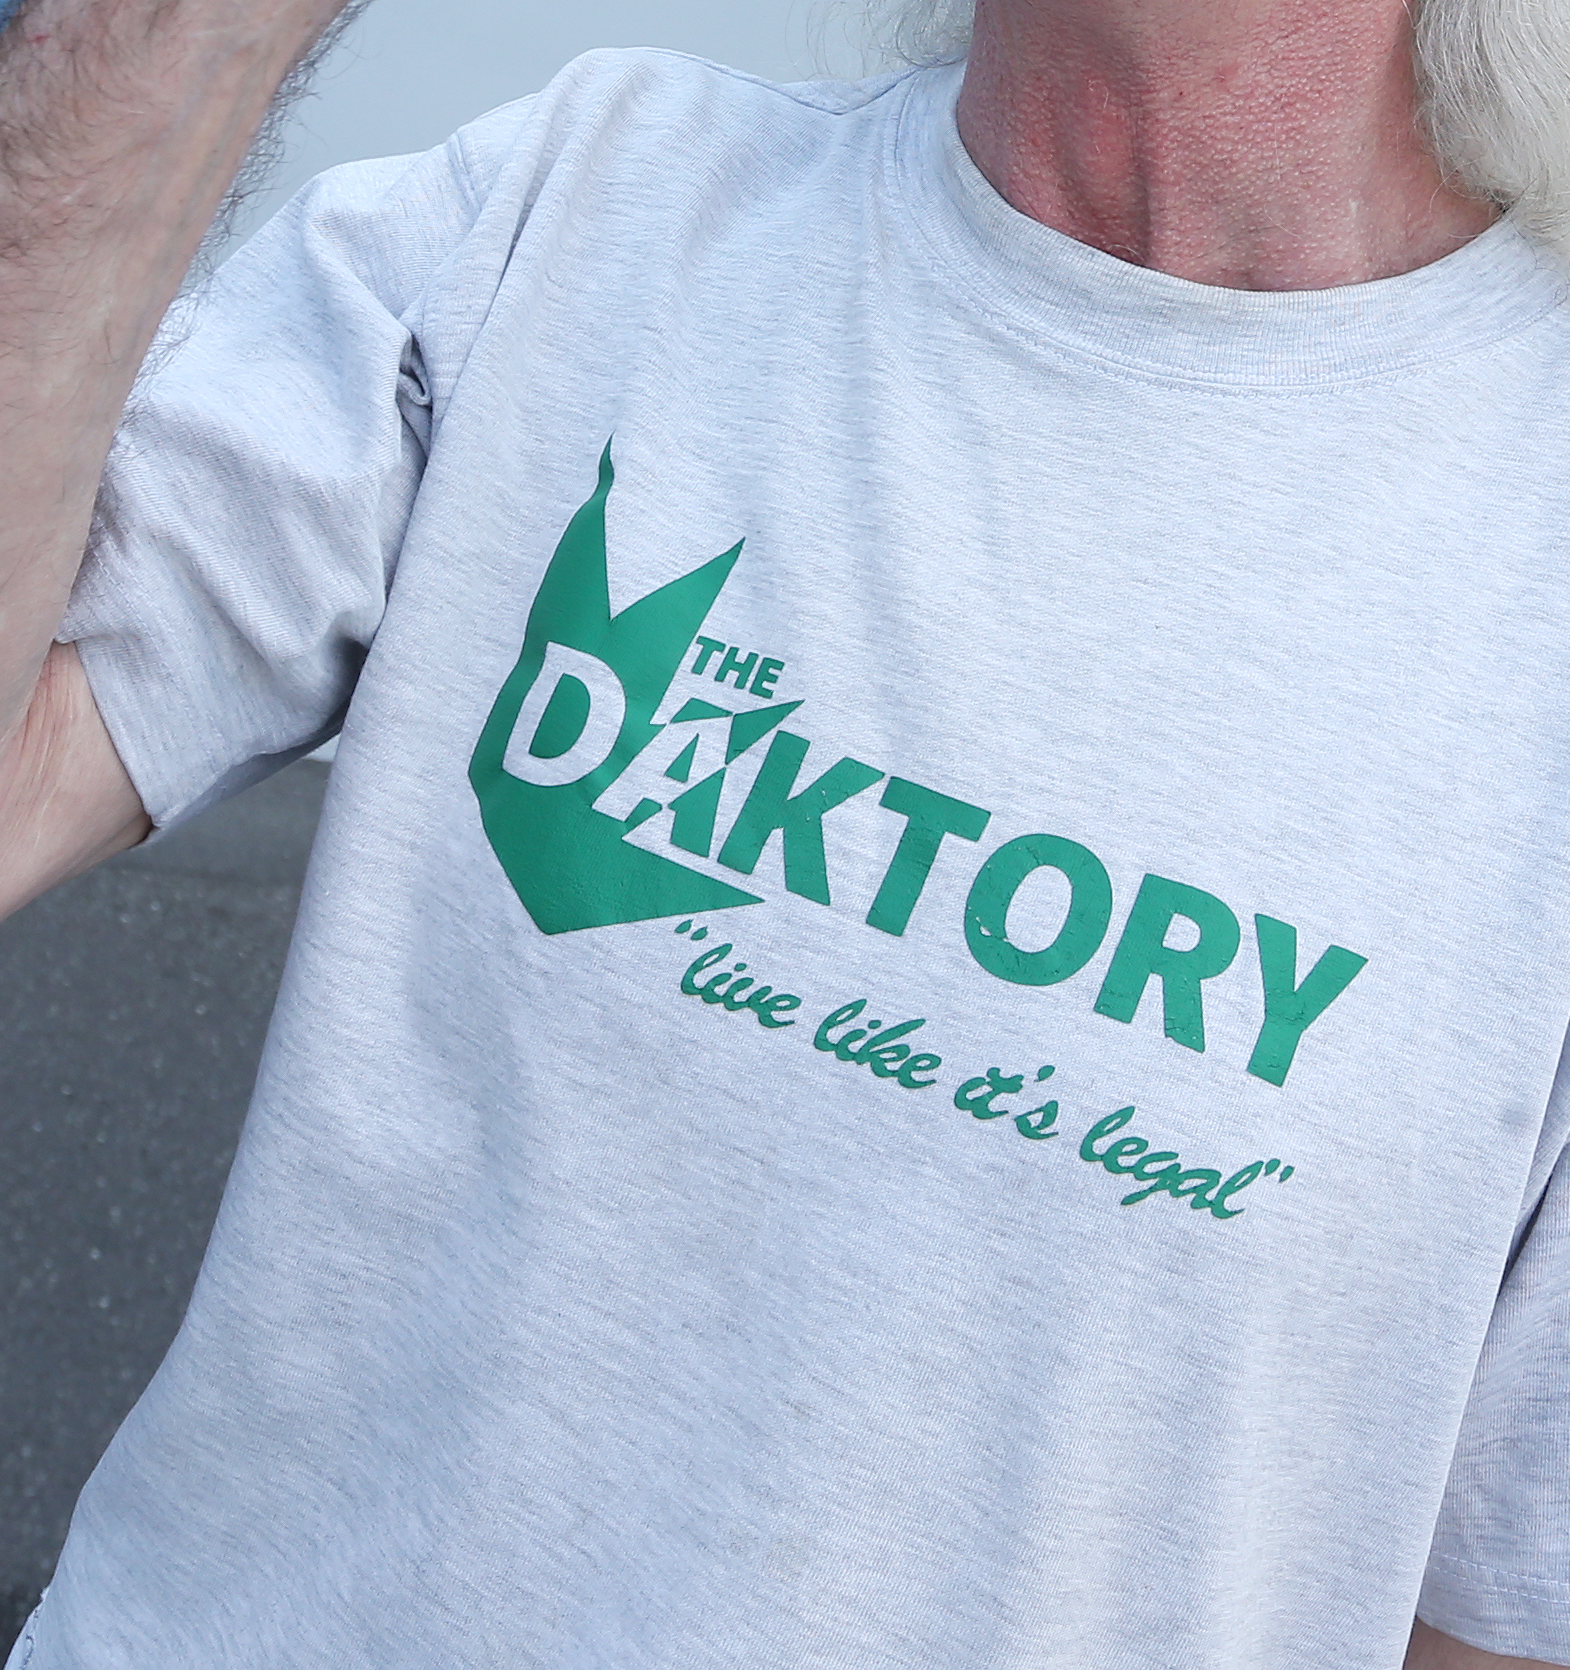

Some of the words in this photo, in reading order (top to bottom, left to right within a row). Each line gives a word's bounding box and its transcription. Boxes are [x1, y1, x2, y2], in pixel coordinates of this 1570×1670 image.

[690, 634, 786, 700] THE
[501, 639, 1369, 1088] DAKTORY
[812, 997, 938, 1090] like
[952, 1064, 1060, 1141] it's
